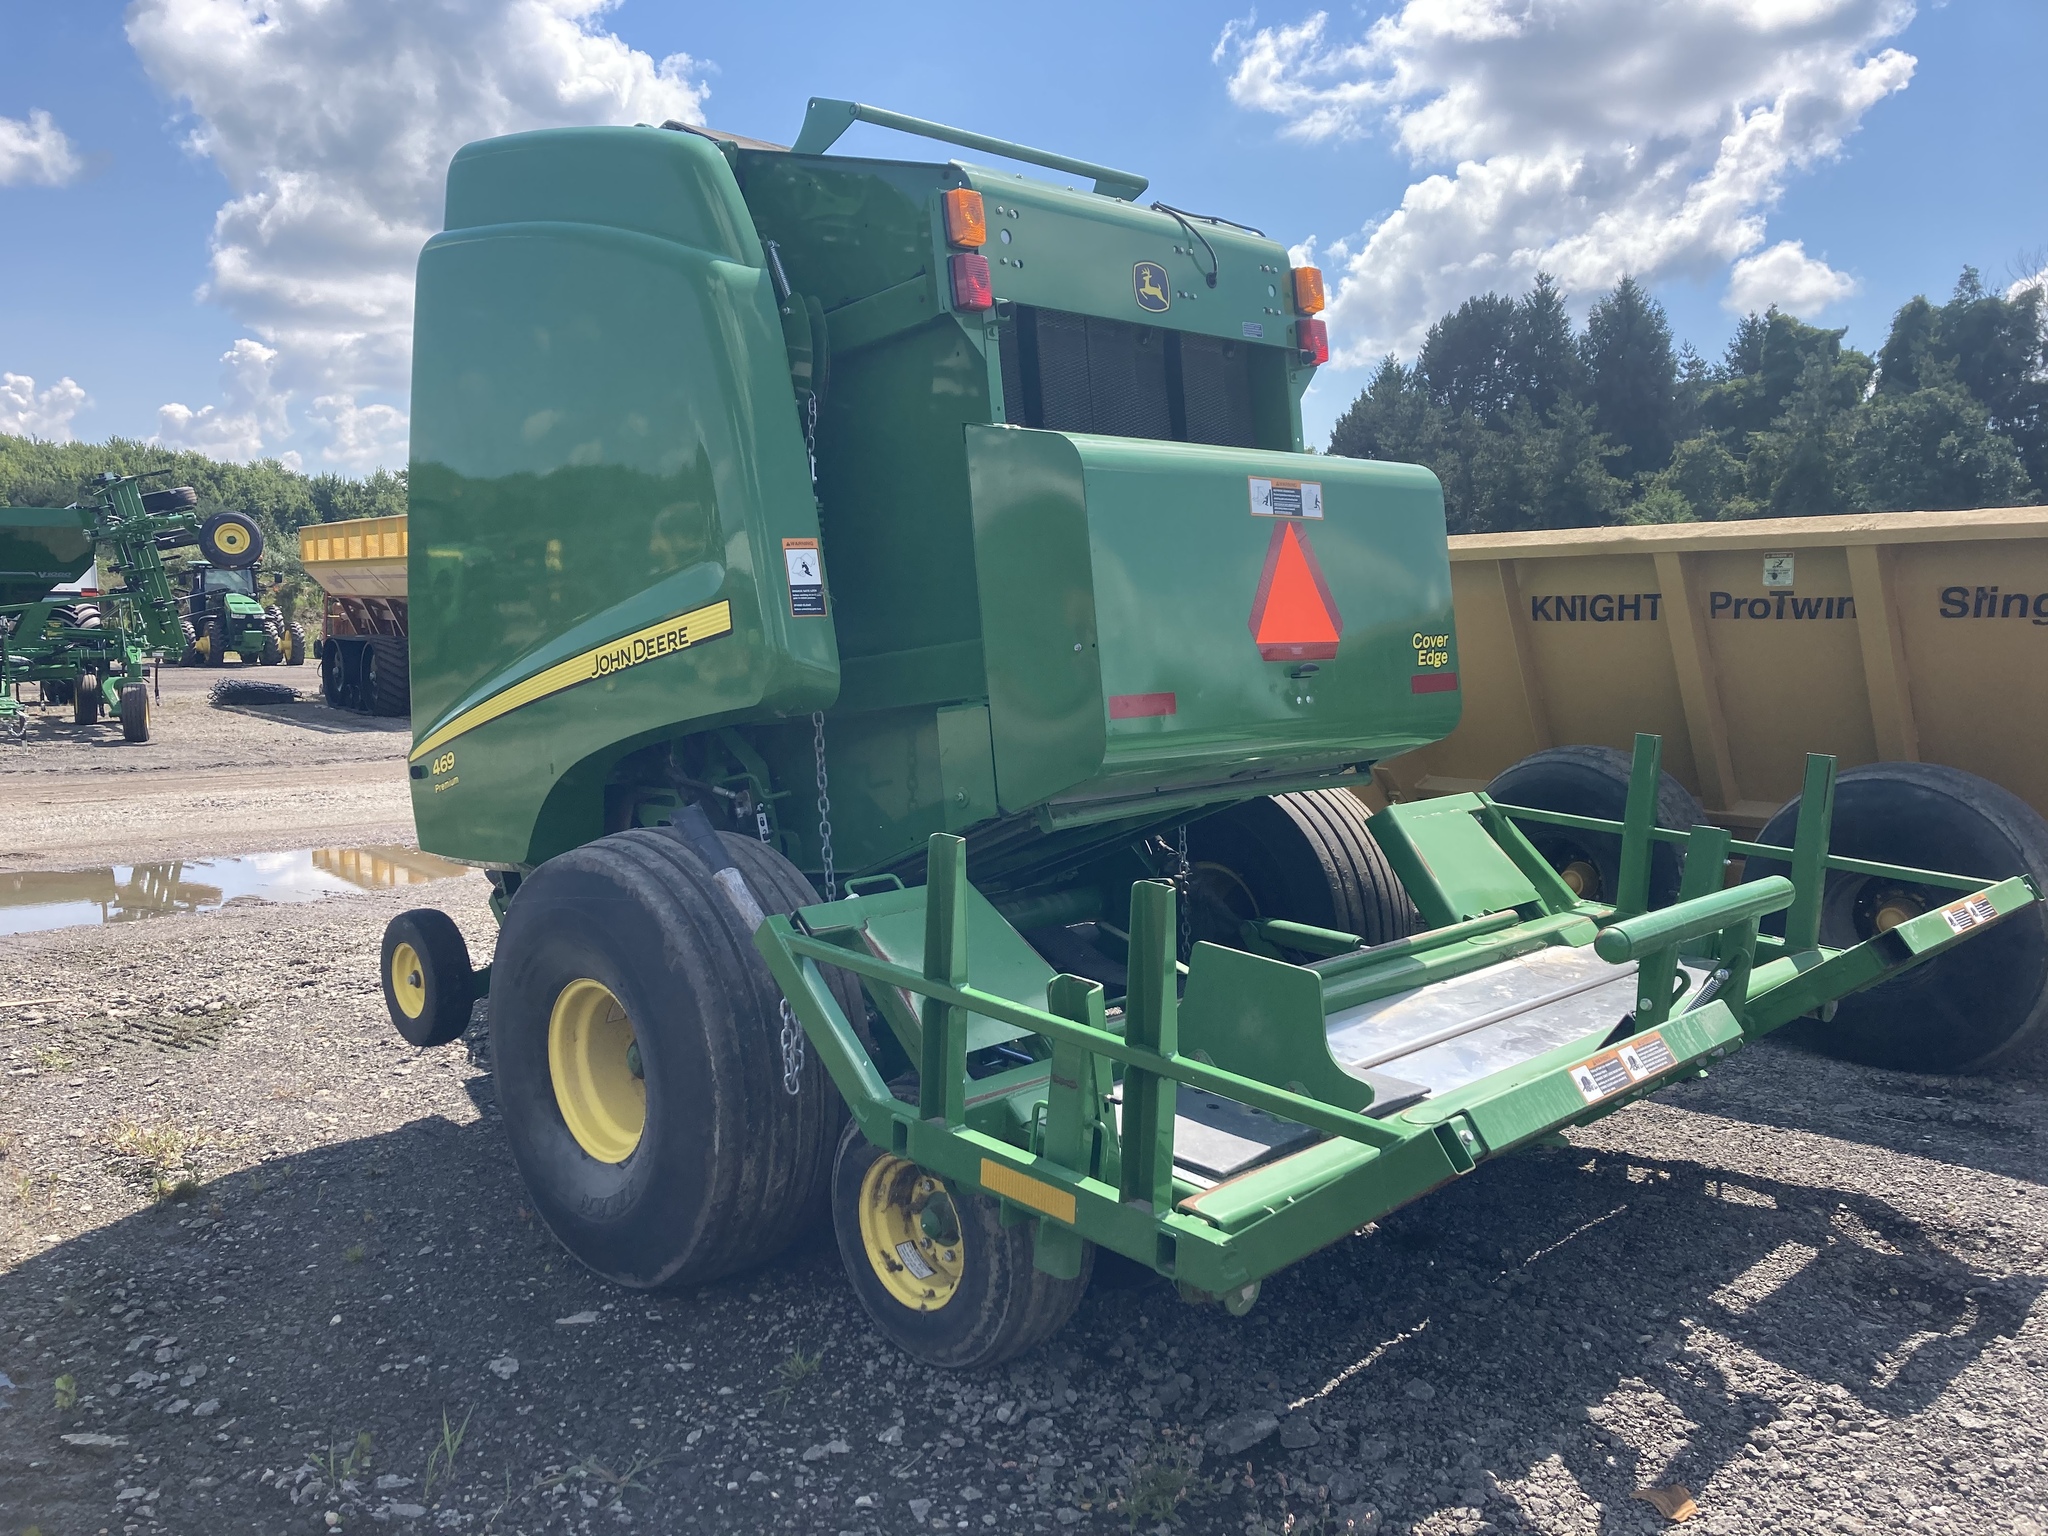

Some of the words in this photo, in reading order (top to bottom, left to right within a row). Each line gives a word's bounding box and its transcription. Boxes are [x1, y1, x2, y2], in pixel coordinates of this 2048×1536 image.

[1532, 593, 1662, 622] KNIGHT
[1709, 590, 1857, 620] ProTwin
[592, 646, 631, 676] JOHN
[633, 626, 689, 660] DEERE
[1412, 632, 1449, 649] Cover
[1418, 650, 1448, 668] Edge
[433, 751, 455, 775] 469
